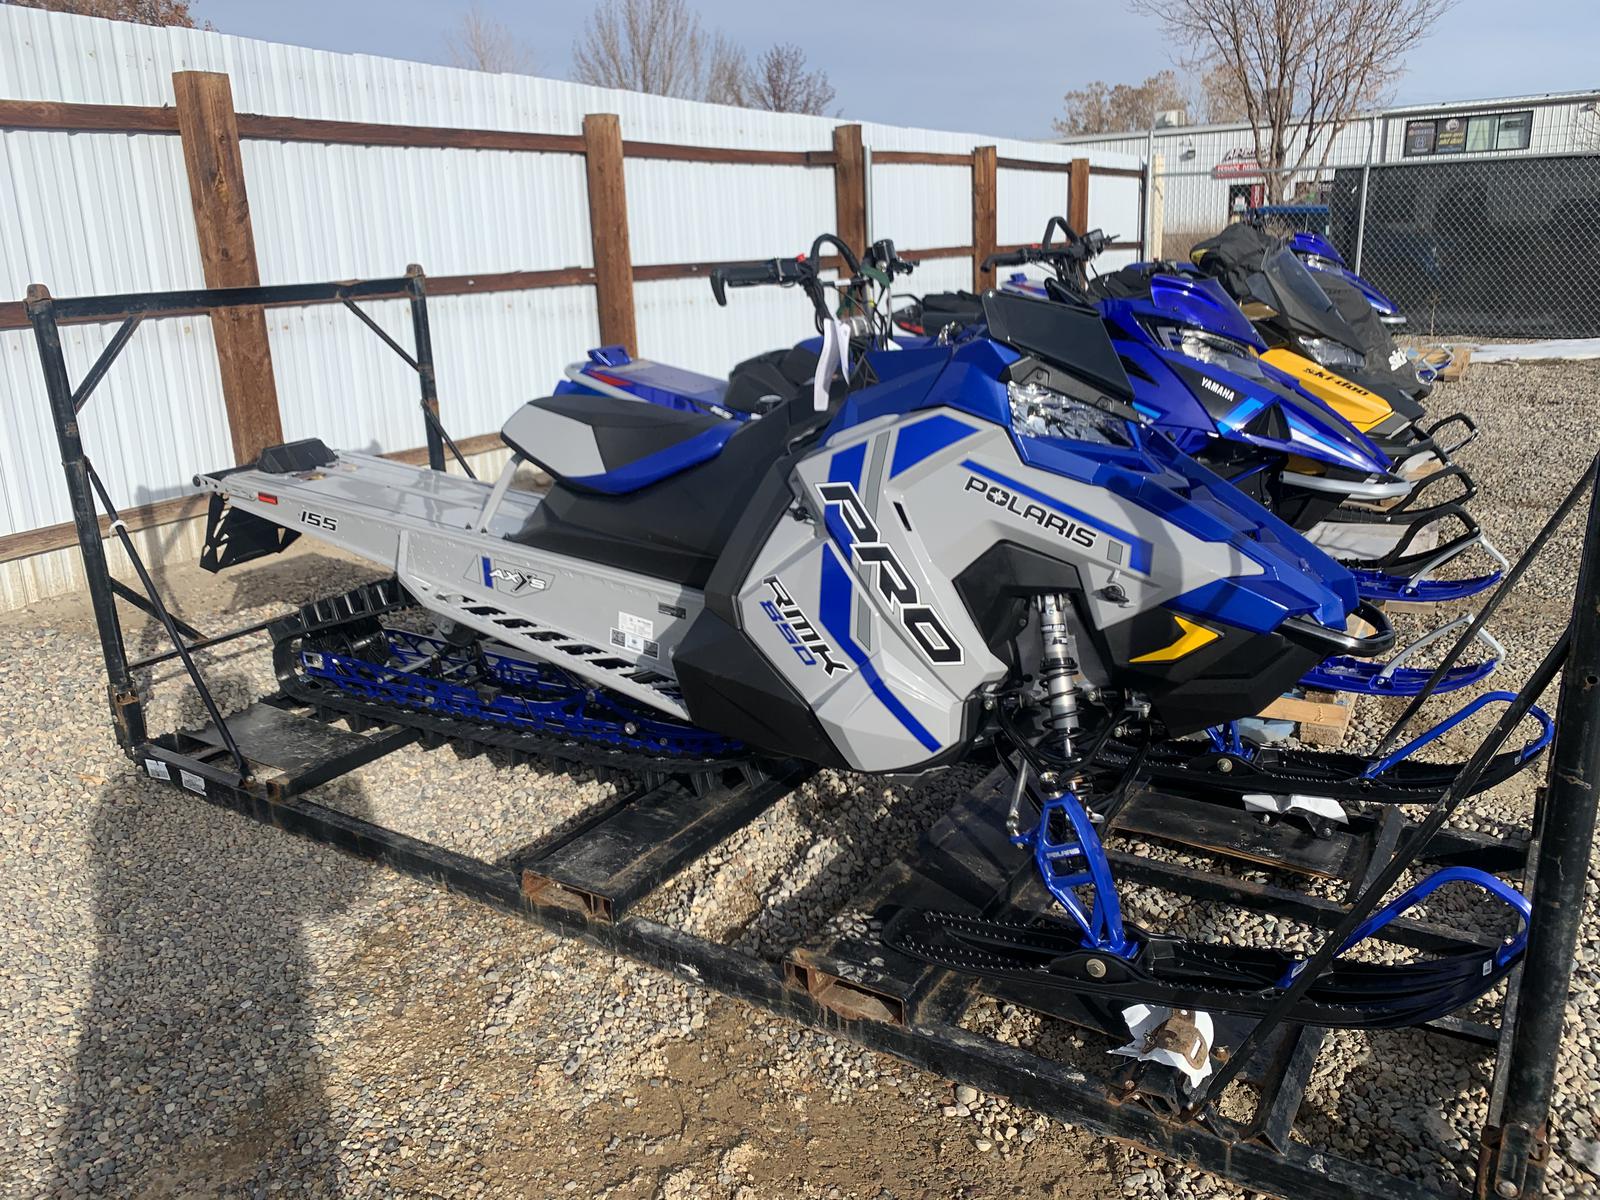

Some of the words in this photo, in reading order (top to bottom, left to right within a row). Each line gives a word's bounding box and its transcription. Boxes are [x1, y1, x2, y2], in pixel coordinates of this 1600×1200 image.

[1201, 376, 1235, 402] YAMAHA
[300, 510, 338, 531] 155
[964, 475, 1097, 548] POLARIS
[816, 482, 964, 665] PRO
[760, 600, 816, 666] 850
[762, 575, 852, 678] RMK
